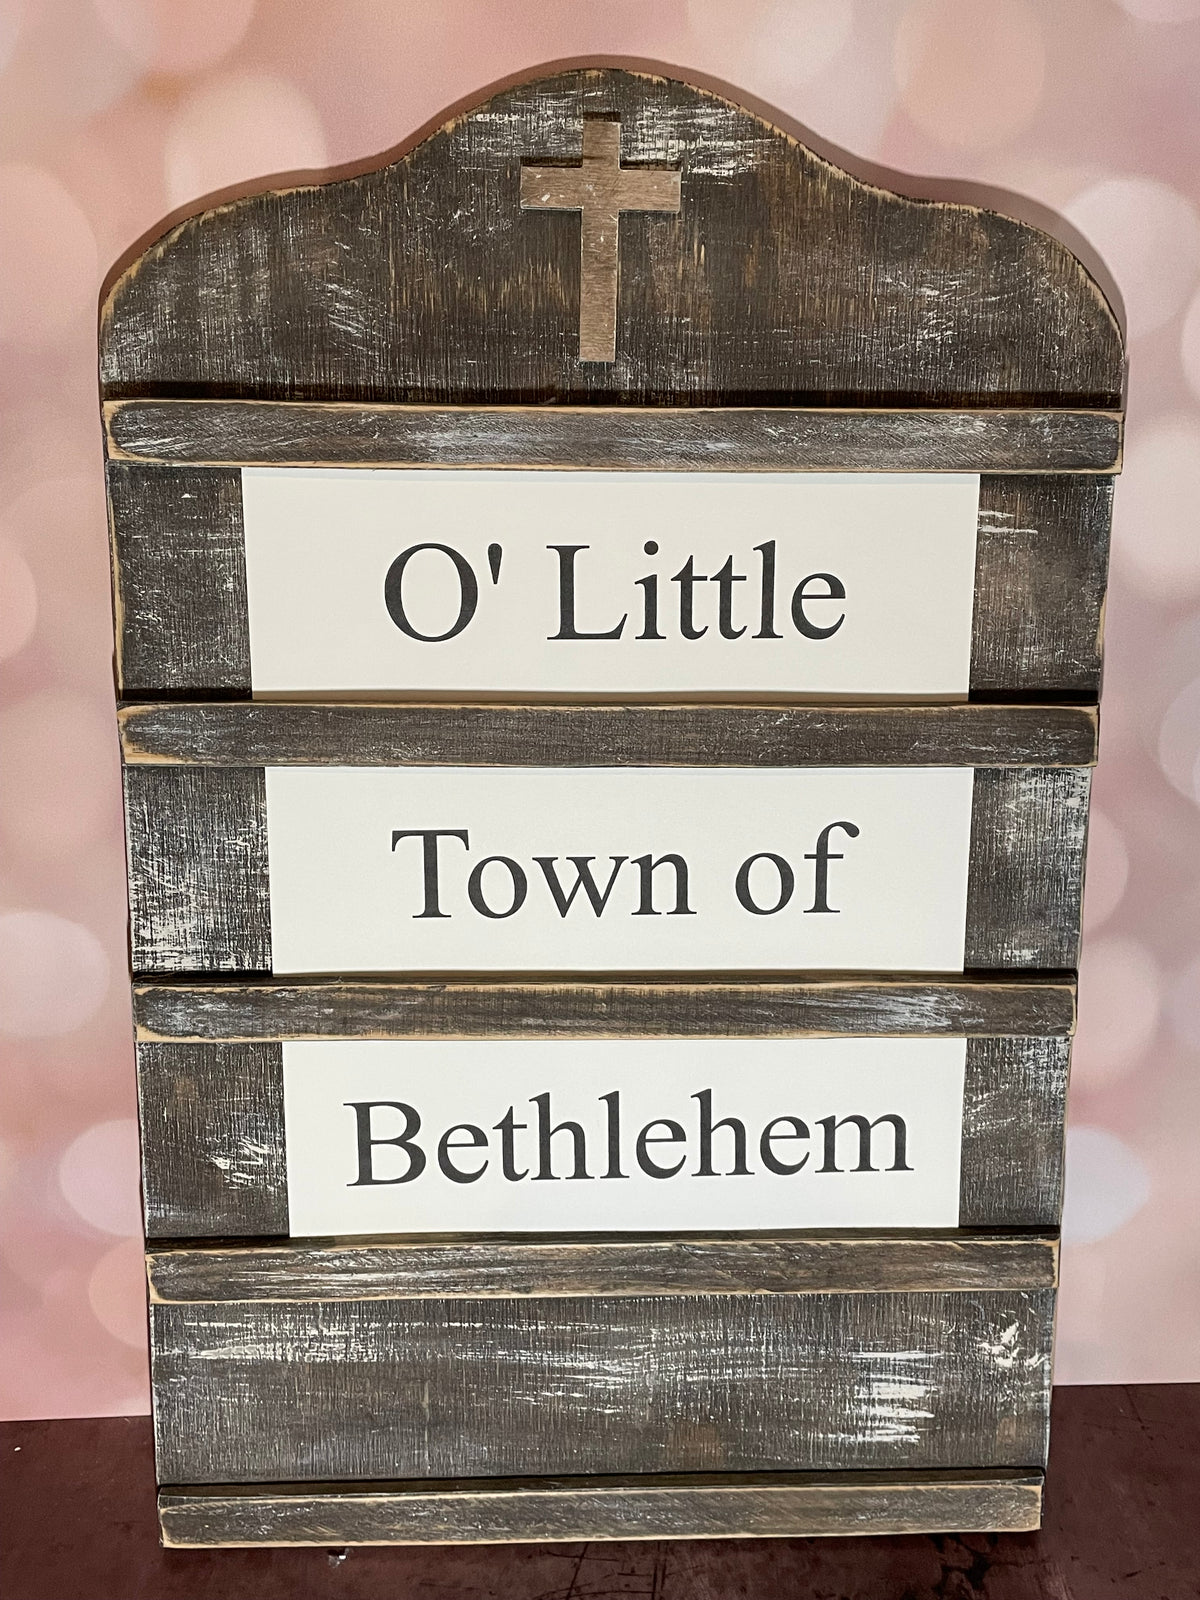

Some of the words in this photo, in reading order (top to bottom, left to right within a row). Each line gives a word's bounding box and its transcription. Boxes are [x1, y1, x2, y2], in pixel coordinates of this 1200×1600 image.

[384, 542, 503, 643] O'
[546, 540, 846, 641] Little
[391, 829, 698, 919] Town
[735, 821, 860, 916] of
[342, 1088, 915, 1187] Bethlehem
